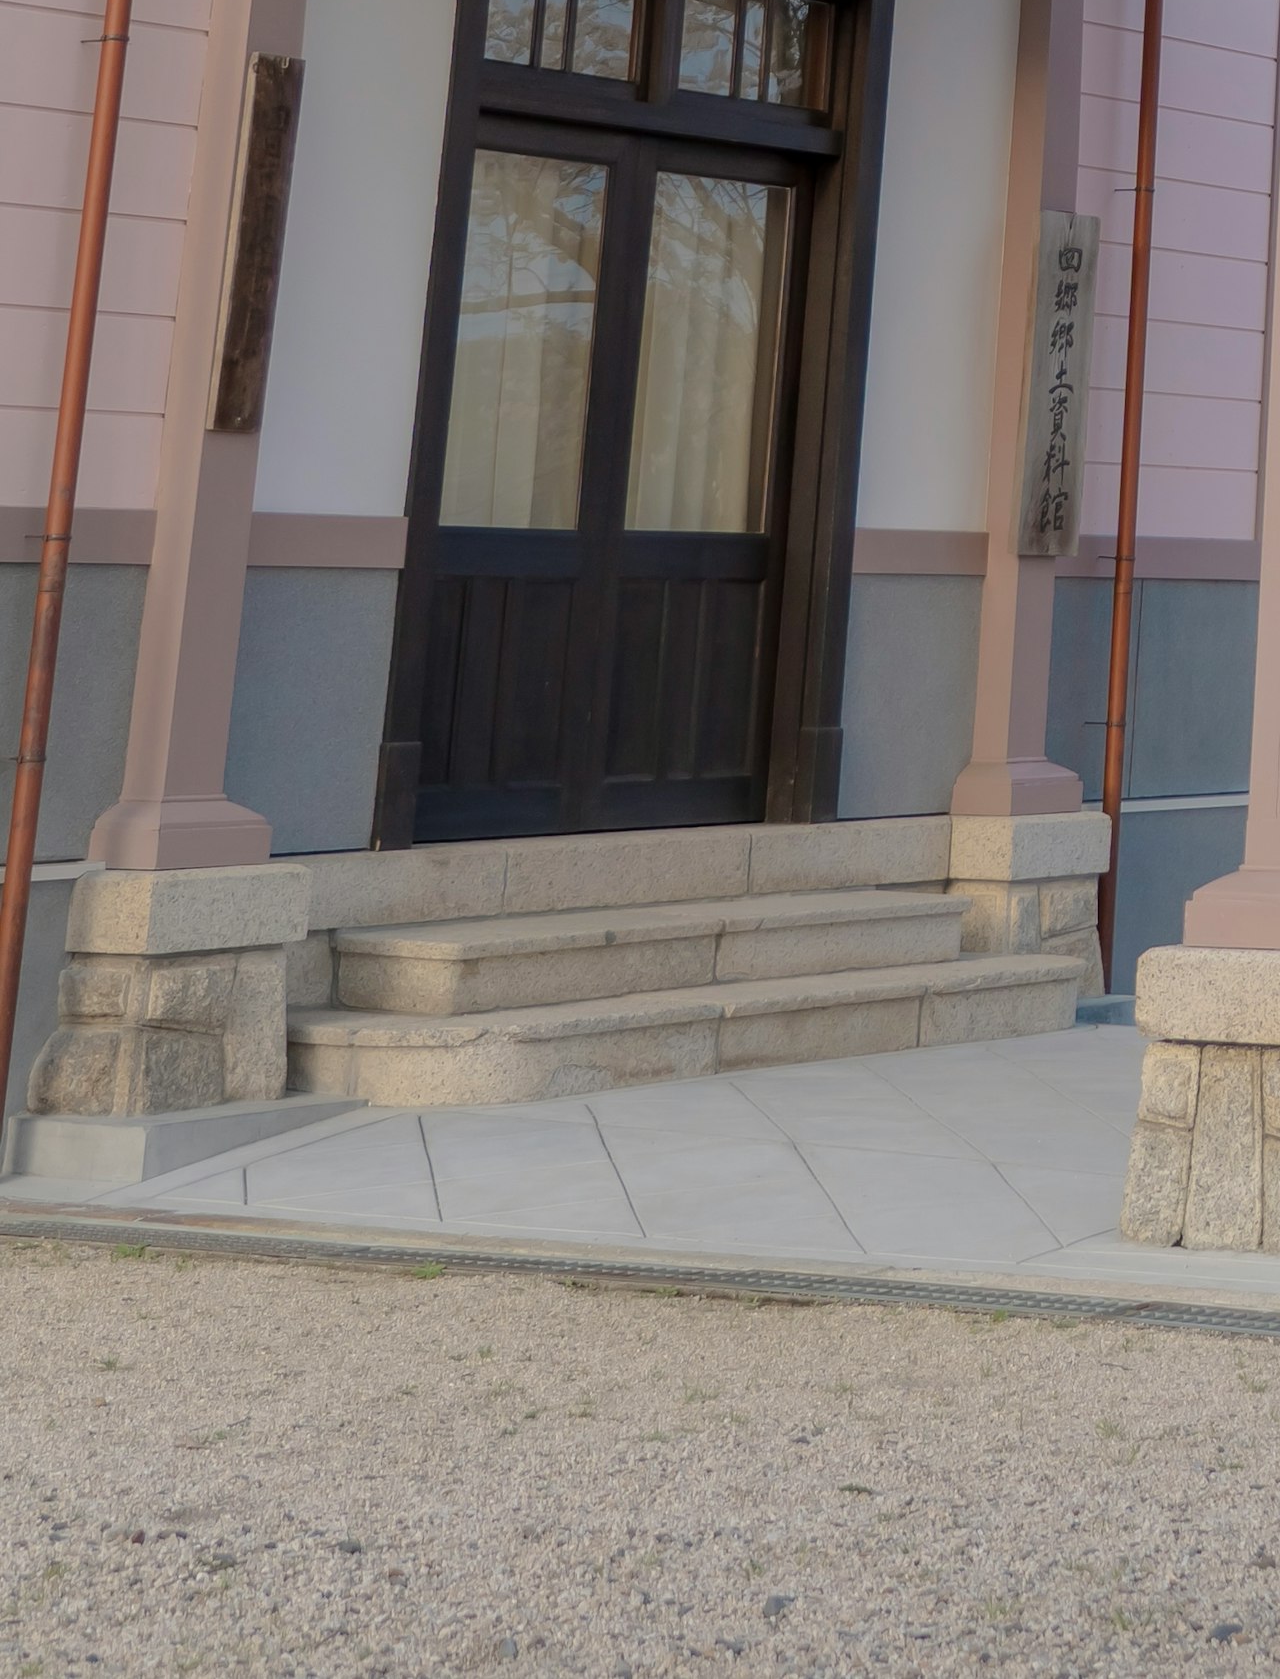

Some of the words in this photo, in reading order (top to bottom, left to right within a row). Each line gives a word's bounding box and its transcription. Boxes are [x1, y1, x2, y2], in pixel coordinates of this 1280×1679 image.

[1039, 246, 1082, 534] 四郷郷土資料館
